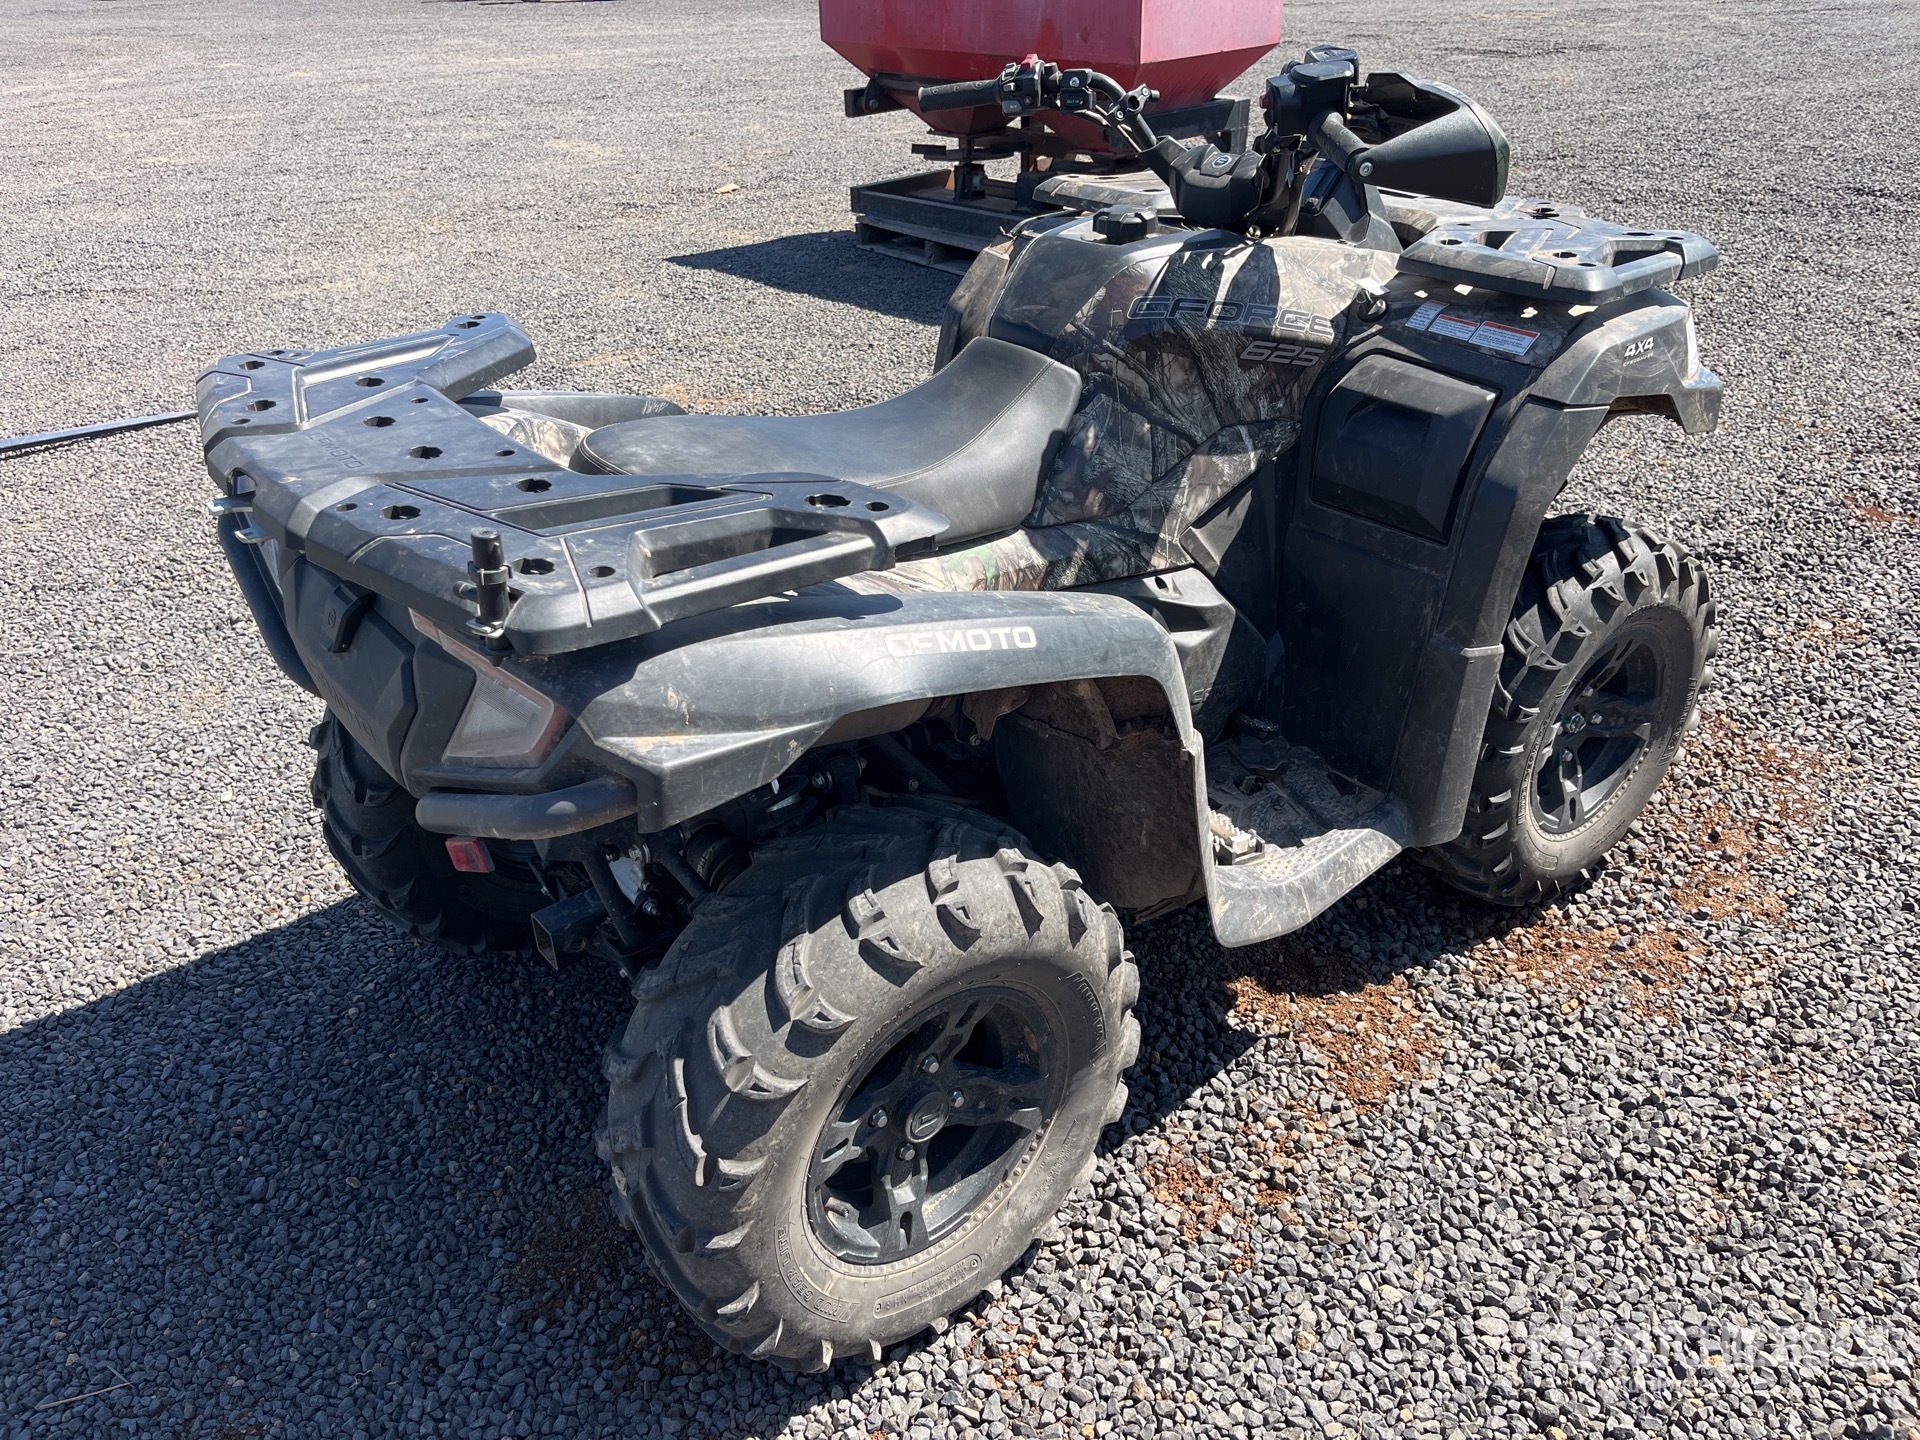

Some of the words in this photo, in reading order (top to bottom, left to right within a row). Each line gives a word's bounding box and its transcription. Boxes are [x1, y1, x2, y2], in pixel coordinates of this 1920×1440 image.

[1127, 295, 1335, 337] CFORCE
[1239, 340, 1326, 367] 625
[884, 625, 1038, 658] CFMOTO
[777, 1225, 793, 1268] LITE
[813, 1297, 842, 1317] MUD
